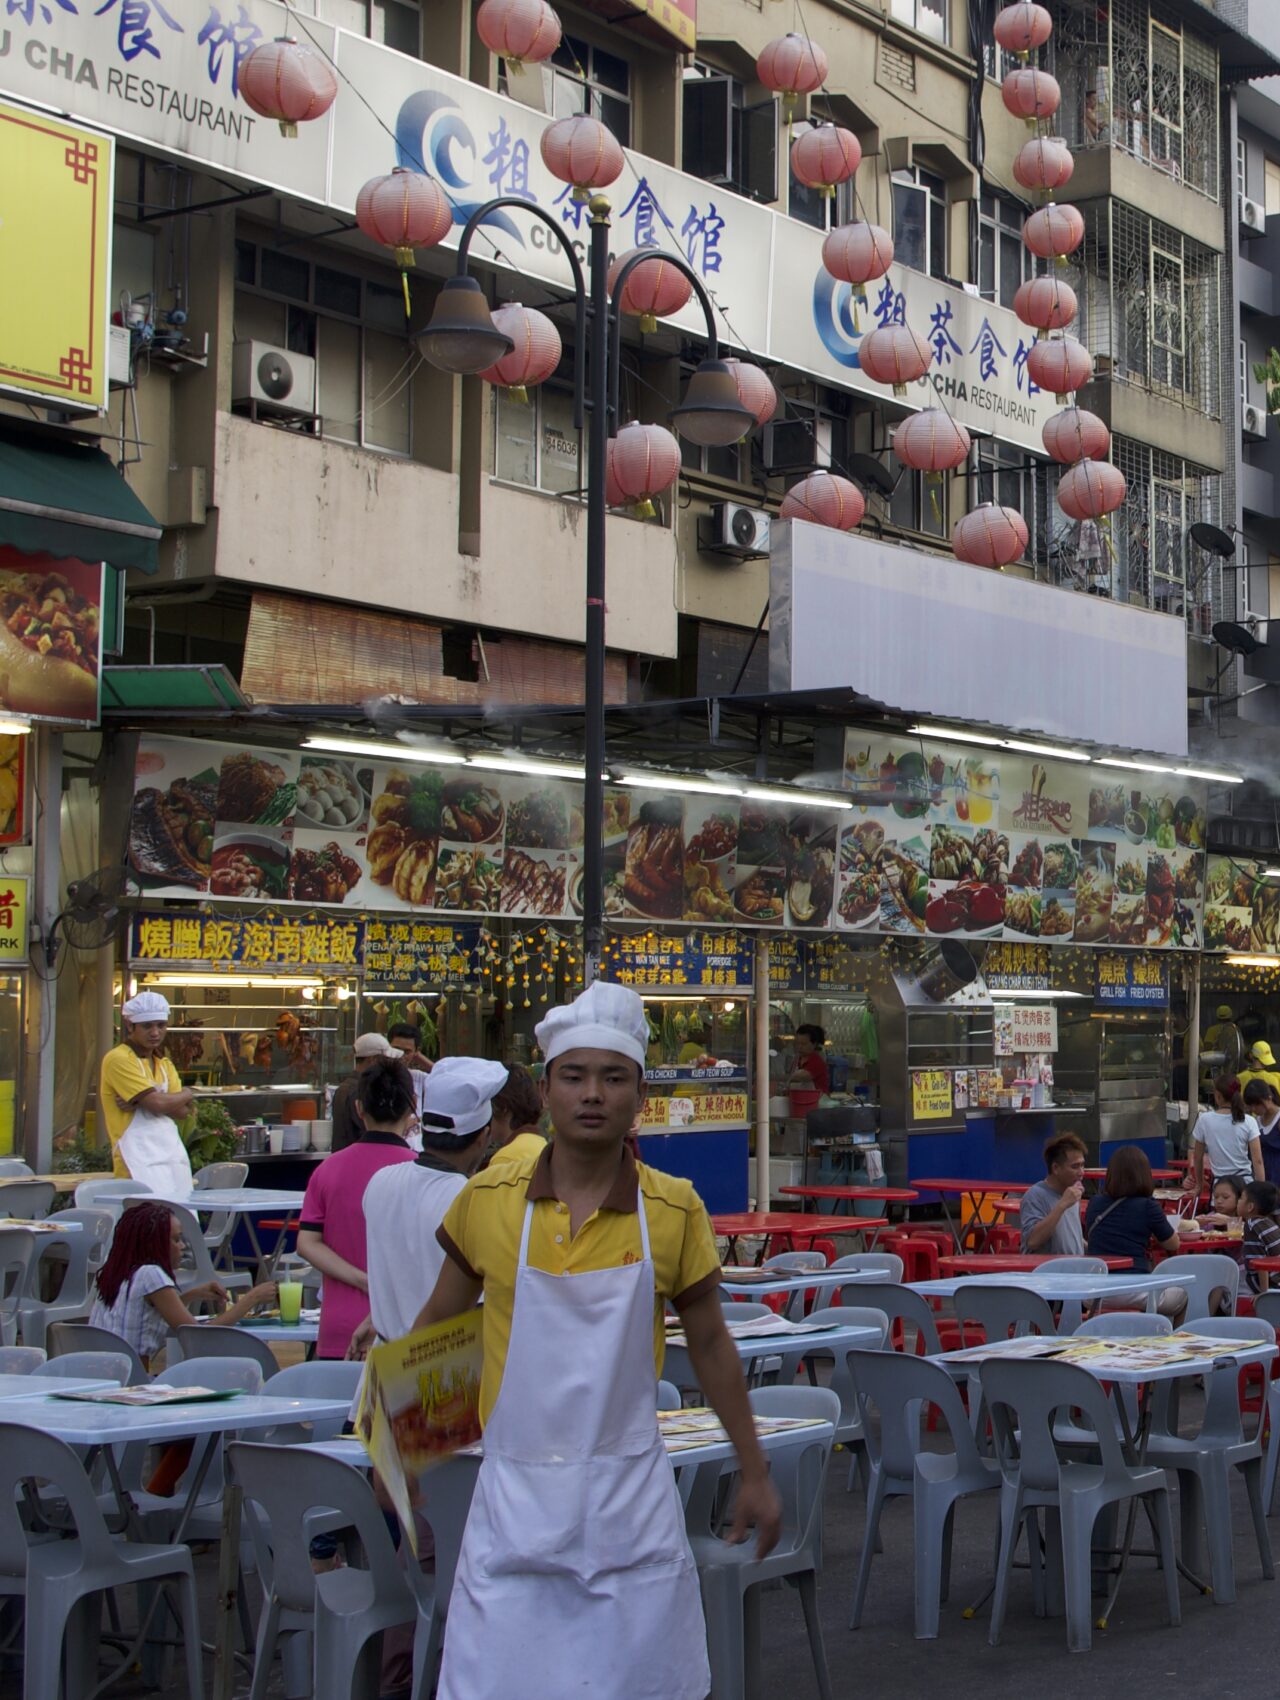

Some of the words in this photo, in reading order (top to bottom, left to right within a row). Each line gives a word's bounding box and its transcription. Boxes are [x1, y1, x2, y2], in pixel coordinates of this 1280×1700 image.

[24, 39, 99, 91] CHA
[107, 66, 256, 144] RESTAURANT
[933, 372, 969, 403] CHA
[970, 387, 1037, 429] RESTAURANT
[1099, 985, 1115, 998] GRILL
[1114, 986, 1127, 998] FISH
[1130, 987, 1145, 999] FRIED
[1145, 987, 1165, 1000] OYSTER
[654, 1069, 678, 1079] CHICKEN
[720, 1067, 735, 1077] SOUP
